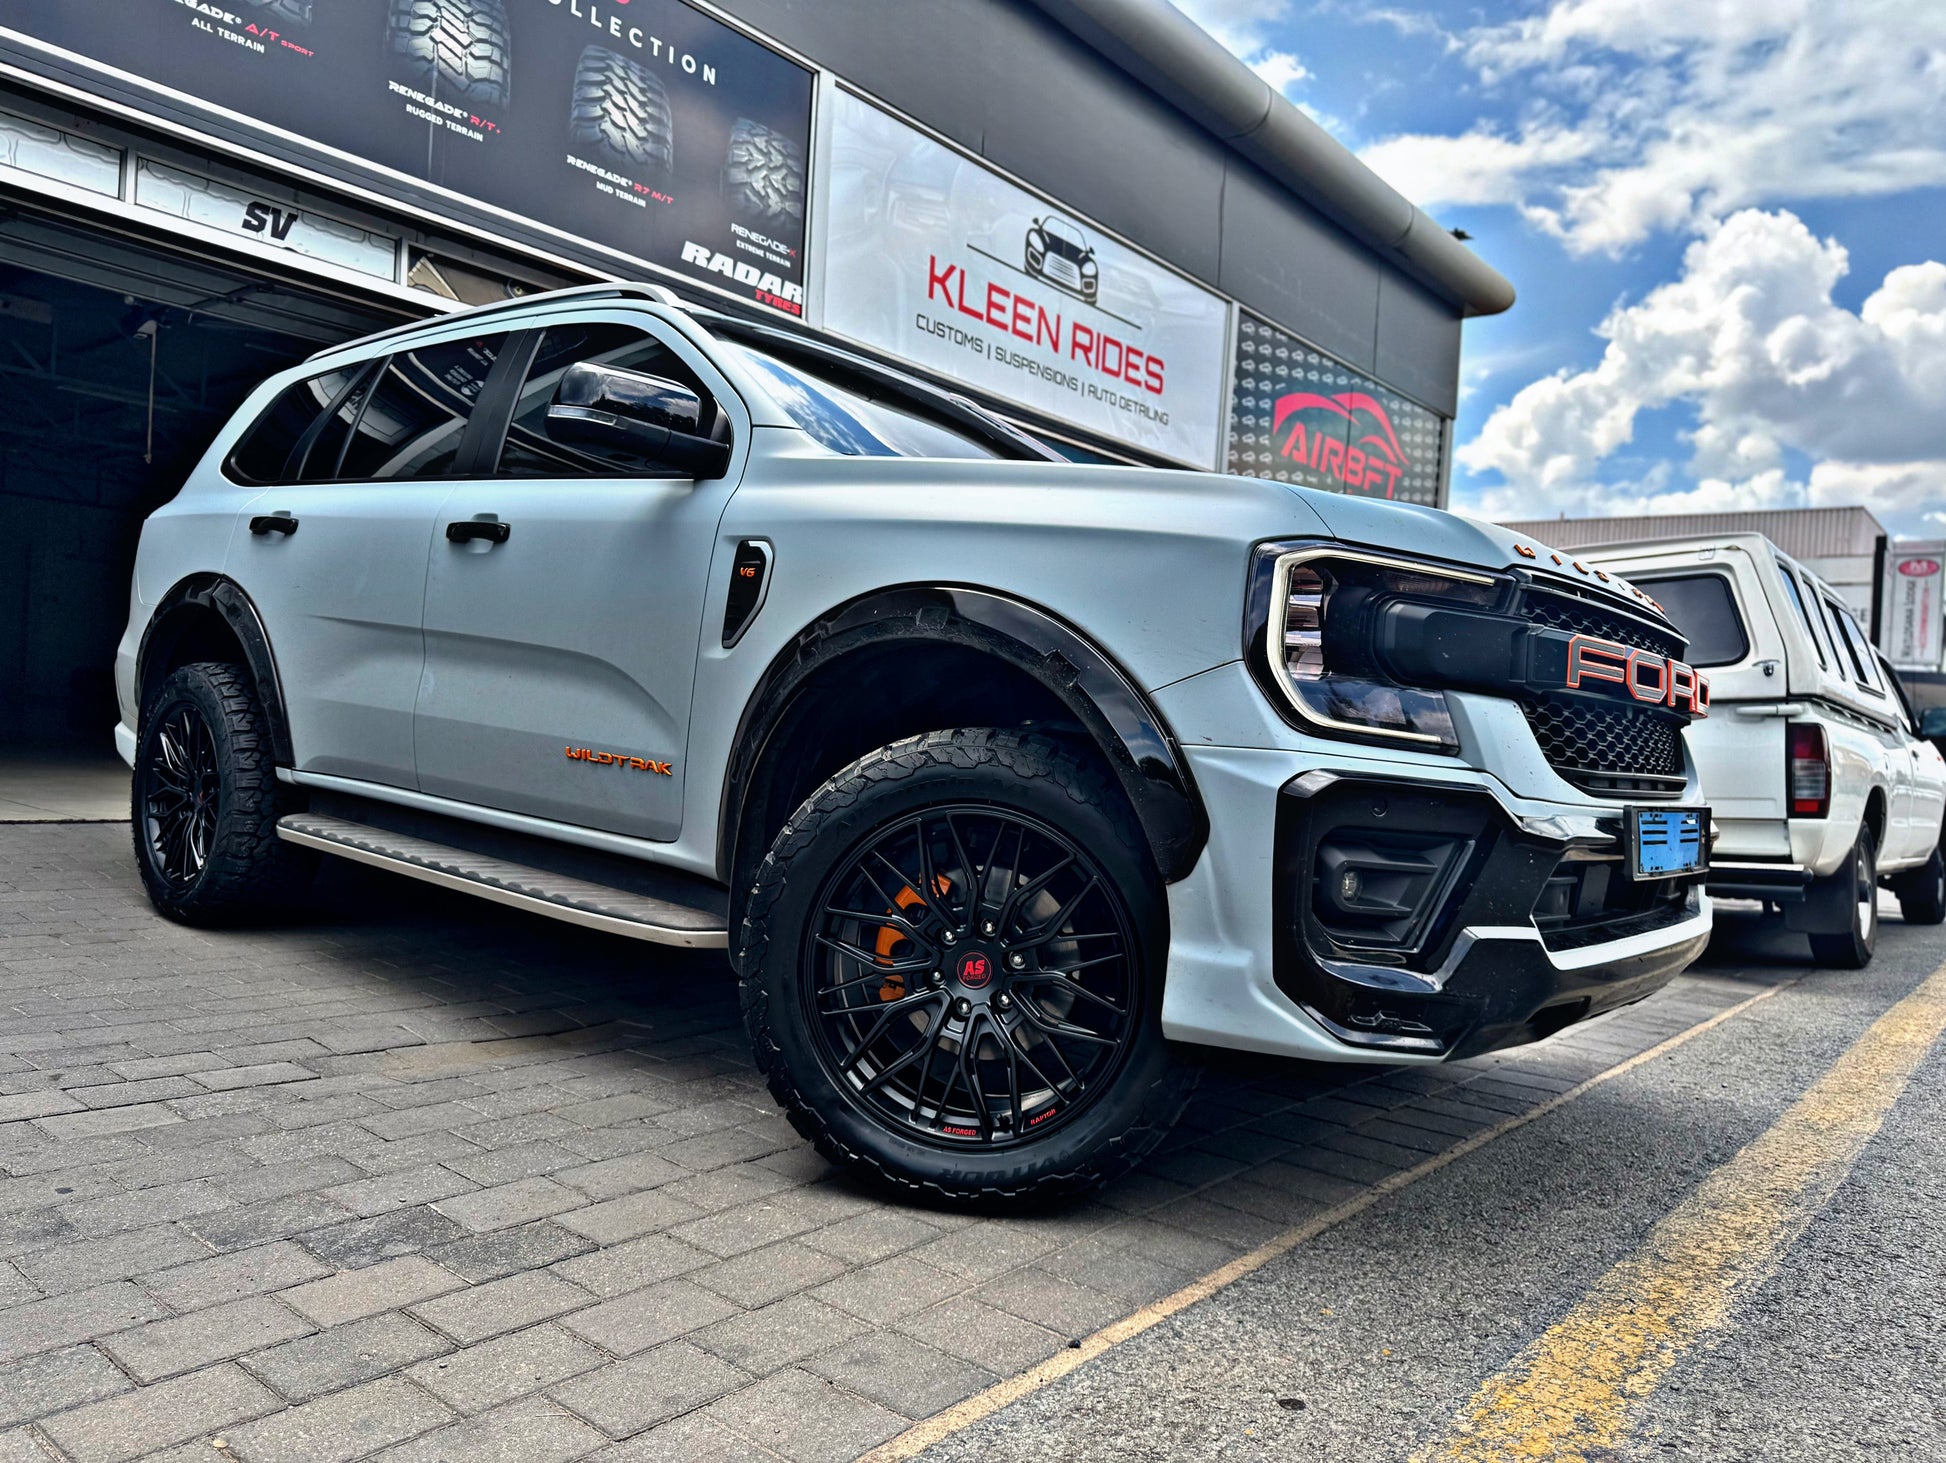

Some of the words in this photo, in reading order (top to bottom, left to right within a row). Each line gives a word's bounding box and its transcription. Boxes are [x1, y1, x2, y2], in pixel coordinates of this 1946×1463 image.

[191, 17, 213, 33] ALL
[217, 27, 265, 53] TERRAIN
[245, 23, 280, 41] A/T
[281, 39, 314, 57] SPORT
[548, 0, 716, 86] LLECTION
[406, 104, 443, 125] RUGGED
[445, 120, 484, 142] TERRAIN
[596, 181, 614, 195] MUD
[615, 189, 646, 208] TERRAIN
[634, 182, 650, 195] R7
[651, 191, 674, 205] M/T
[241, 201, 298, 241] SV
[736, 239, 765, 258] EXTREME
[765, 251, 791, 268] TERRAIN
[681, 240, 802, 306] RADAR
[755, 288, 801, 316] TYRES
[928, 254, 1061, 354] KLEEN
[1071, 321, 1165, 396] RIDES
[916, 313, 983, 354] CUSTOMS
[995, 346, 1078, 392] SUSPENSIONS
[1088, 383, 1117, 406] AUTO
[1119, 396, 1169, 426] DETAILING
[1280, 421, 1403, 500] AIRBFT
[740, 567, 756, 579] V6
[1566, 634, 1710, 718] FORD
[565, 746, 673, 777] WILDTRAK
[963, 959, 986, 976] AS
[952, 1126, 977, 1136] FORGED
[1030, 1108, 1057, 1126] RAPTOR
